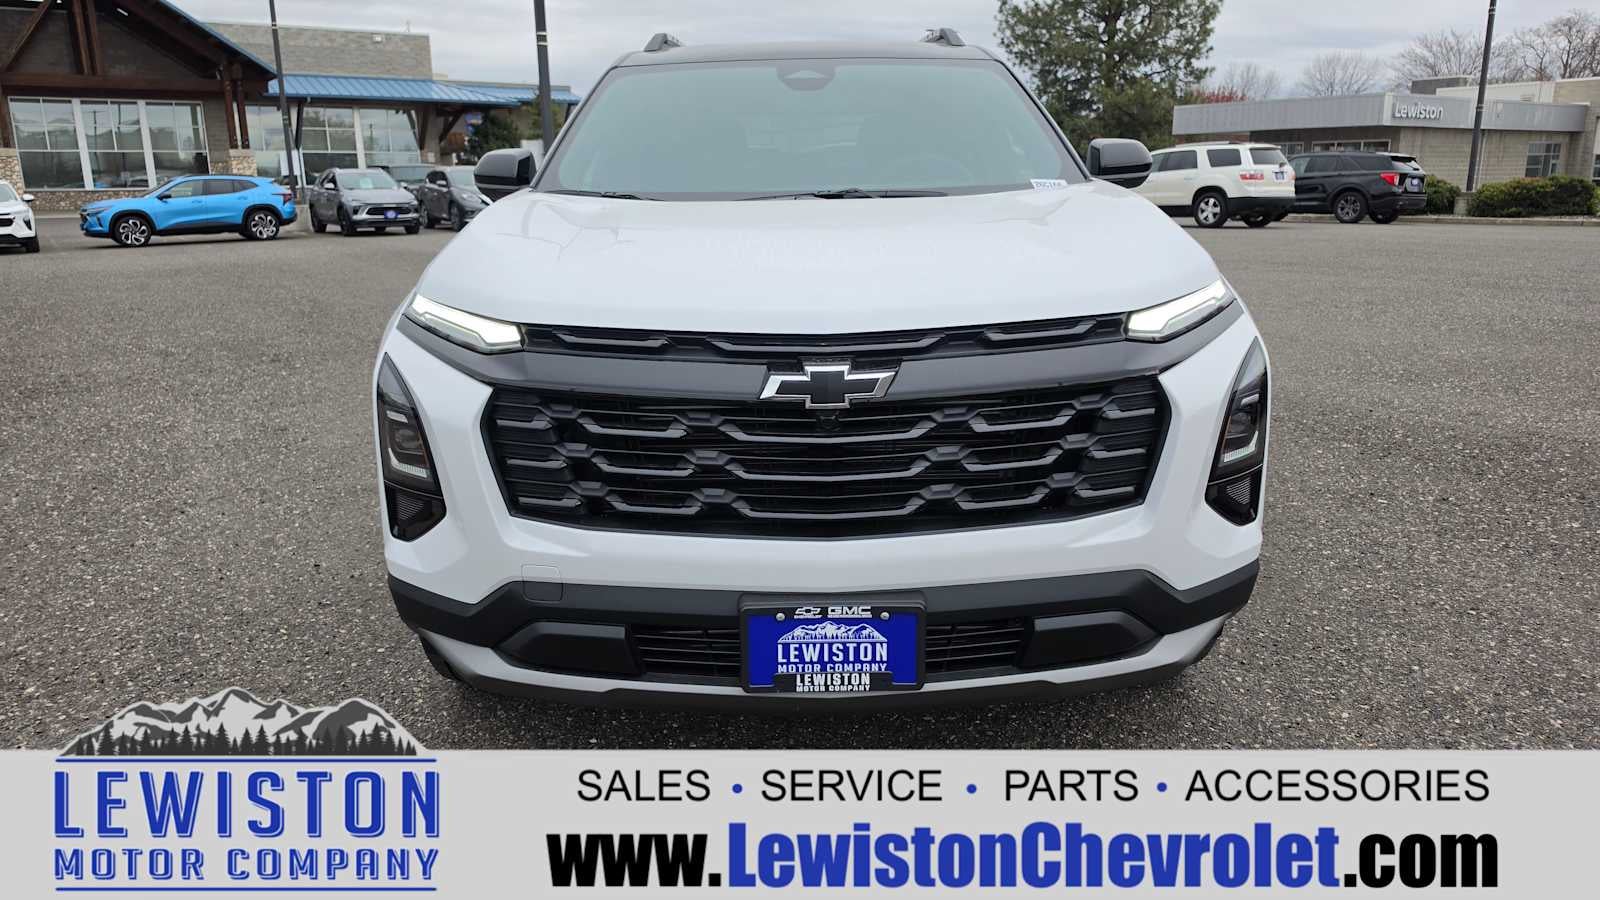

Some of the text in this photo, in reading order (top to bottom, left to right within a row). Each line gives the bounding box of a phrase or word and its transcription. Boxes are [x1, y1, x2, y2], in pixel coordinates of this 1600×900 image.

[1394, 101, 1444, 120] Lewiston
[827, 606, 872, 615] GMC
[777, 642, 888, 662] LEWISTON
[777, 663, 888, 674] MOTOR COMPANY
[796, 673, 870, 686] LEWISTON
[828, 684, 871, 692] COMPANY
